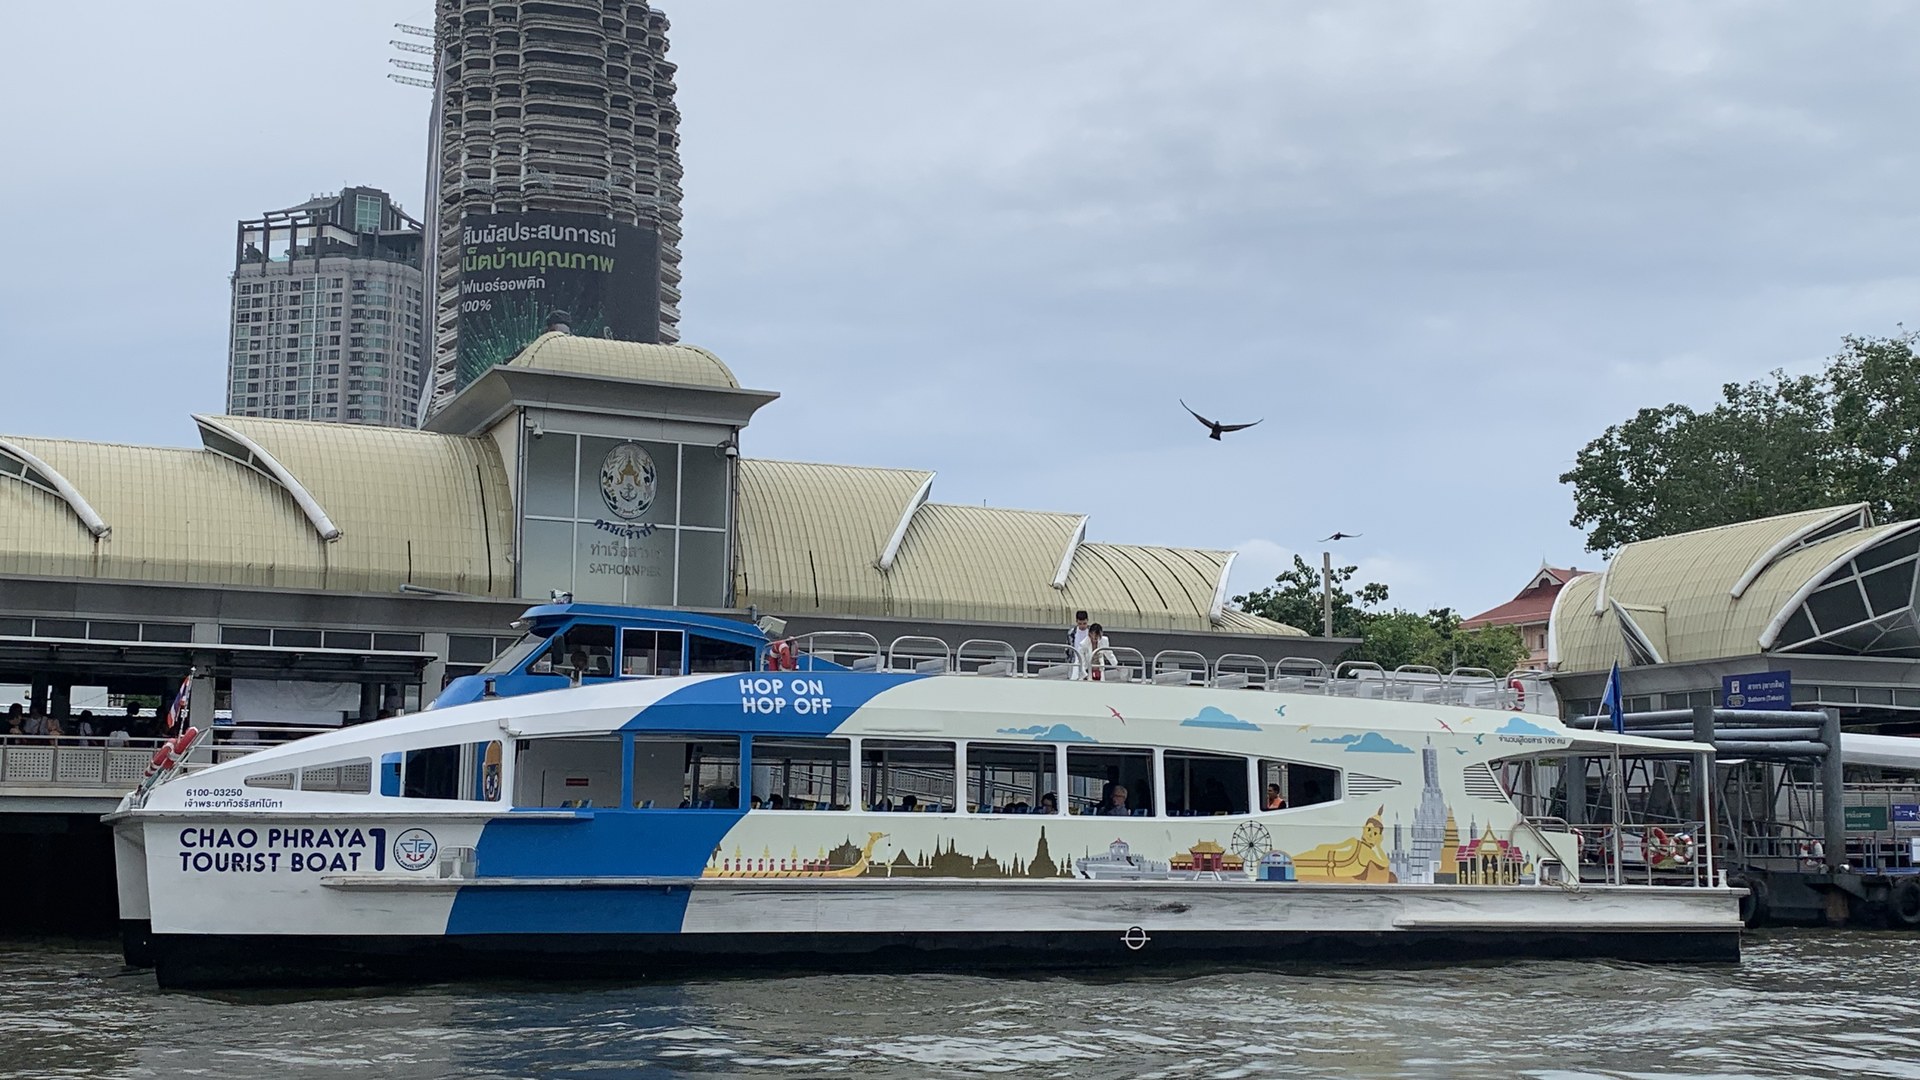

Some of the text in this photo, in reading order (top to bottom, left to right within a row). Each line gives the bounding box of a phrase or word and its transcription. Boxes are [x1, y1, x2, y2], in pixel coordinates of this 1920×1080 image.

[463, 222, 616, 248] สัมผัสประสบการณ์
[462, 247, 615, 274] เน็ตบ้านคุณภาพ
[461, 299, 492, 314] 100%
[589, 563, 640, 576] SATHORN
[740, 679, 824, 696] HOP ON
[742, 697, 832, 715] HOP OFF
[186, 788, 243, 797] 6100-03250
[180, 828, 366, 848] CHAO PHRAYA
[369, 828, 386, 871] 1
[179, 852, 361, 872] TOURIST BOAT
